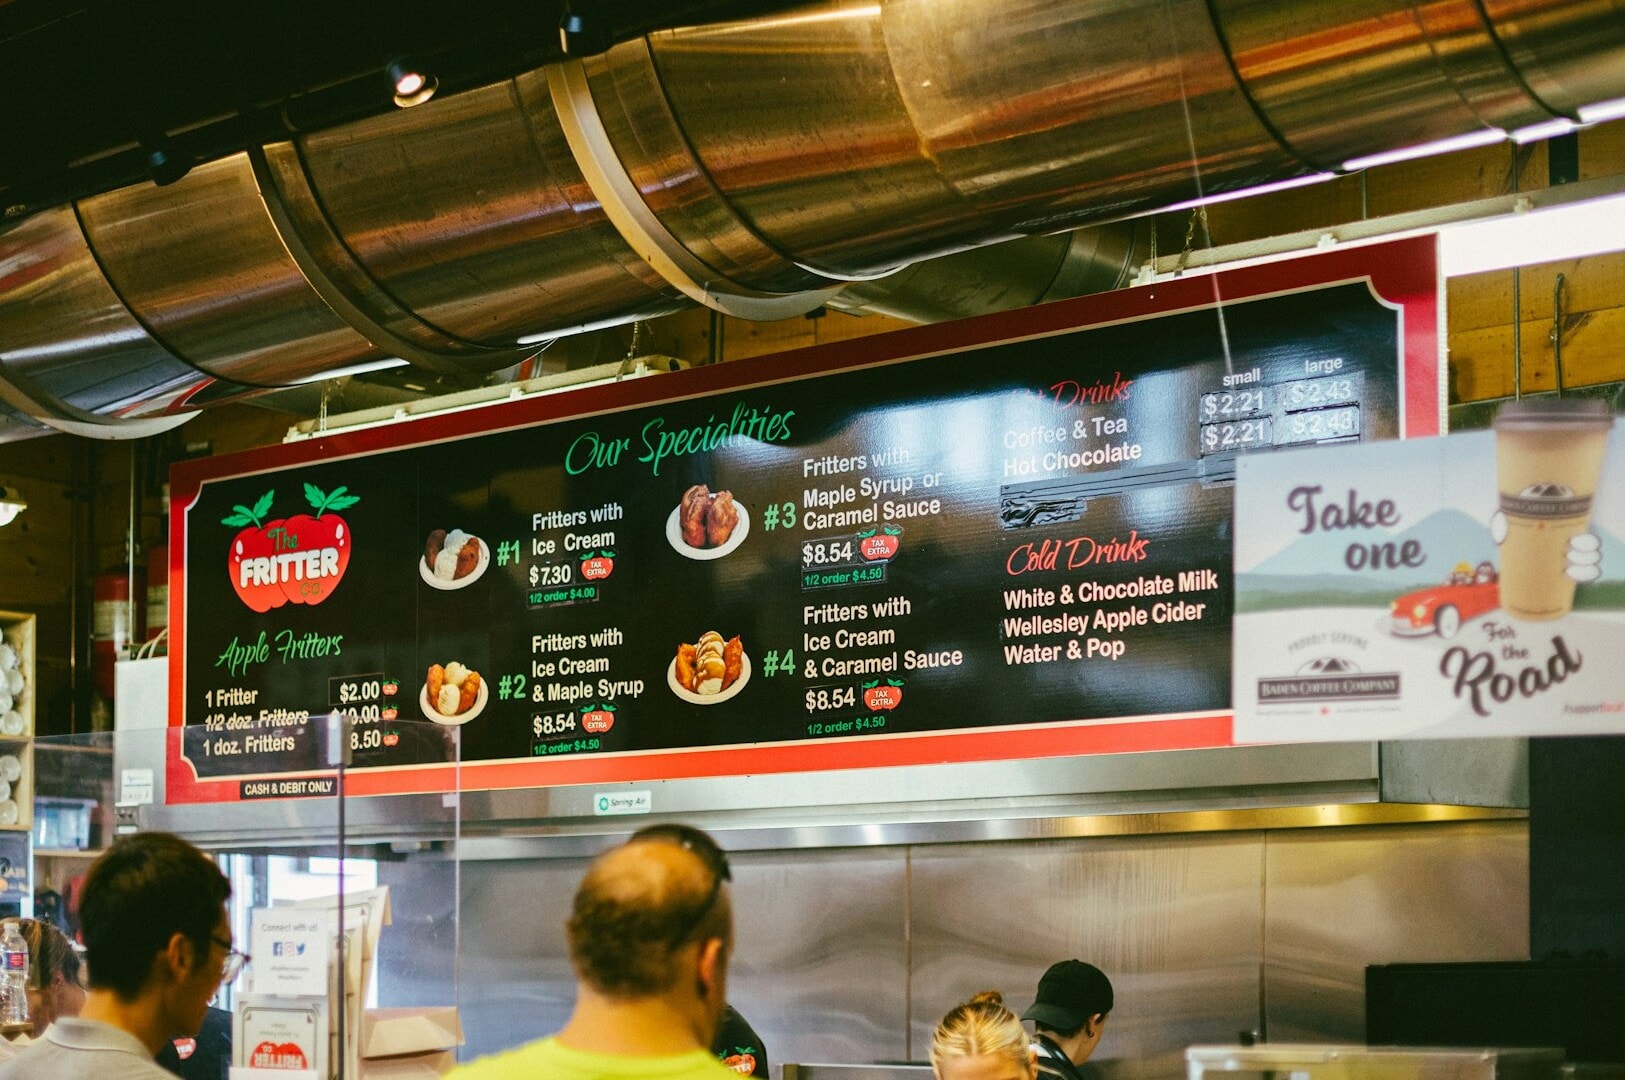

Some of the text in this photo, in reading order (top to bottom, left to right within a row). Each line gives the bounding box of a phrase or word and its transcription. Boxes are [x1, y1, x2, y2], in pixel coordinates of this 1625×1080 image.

[1222, 368, 1261, 386] small
[1305, 358, 1343, 374] large
[1050, 371, 1134, 410] Drinks
[1205, 391, 1263, 419] $2.21
[564, 401, 796, 477] Our Specialities
[1004, 416, 1127, 449] Coffee & Tea
[1205, 421, 1264, 449] $2.21
[803, 447, 910, 477] Fritters with
[1004, 442, 1142, 477] Hot Chocolate
[803, 471, 943, 509] Maple Syrup or
[533, 502, 623, 531] Fritters with
[764, 502, 796, 531] #3
[803, 499, 941, 530] Caramel Sauce
[1287, 485, 1400, 534] Take
[267, 528, 298, 551] The
[532, 531, 615, 556] Ice Cream
[867, 547, 890, 556] EXTRA
[871, 539, 885, 547] TAX
[497, 540, 520, 567] #1
[590, 561, 602, 569] TAX
[802, 541, 852, 566] $8.54
[1007, 530, 1150, 576] Cold Drinks
[1344, 539, 1427, 571] one
[240, 547, 339, 588] FRITTER
[529, 564, 571, 587] $7.30
[586, 567, 607, 576] EXTRA
[804, 567, 882, 586] 1/2 order $4.50
[529, 587, 595, 604] 1/2 order $4.00
[1004, 568, 1218, 611] White & Chocolate Milk
[803, 596, 911, 625] Fritters with
[1004, 600, 1206, 638] Wellesley Apple Cider
[532, 627, 623, 654] Fritters with
[803, 629, 895, 652] Ice Cream
[1482, 621, 1517, 641] For
[215, 629, 343, 677] Apple Fritters
[764, 649, 796, 677] #4
[804, 649, 963, 678] & Caramel Sauce
[1004, 638, 1125, 666] Water & Pop
[1502, 645, 1529, 659] the
[532, 657, 609, 678] Ice Cream
[1440, 635, 1583, 717] Road
[205, 687, 258, 708] 1 Fritter
[339, 680, 380, 704] $2.00
[499, 674, 526, 700] #2
[533, 678, 644, 704] & Maple Syrup
[874, 690, 888, 698] TAX
[1262, 679, 1396, 697] BADEN COFFEE COMPANY
[805, 687, 856, 713] $8.54
[870, 698, 894, 707] EXTRA
[205, 708, 309, 732] 1/2 doz. Fritters
[533, 712, 576, 738] $8.54
[587, 720, 607, 729] EXTRA
[591, 714, 603, 722] TAX
[807, 715, 885, 736] 1/2 order $4.50
[203, 734, 295, 756] 1 doz. Fritters
[534, 739, 599, 755] 1/2 order $4.50
[245, 780, 333, 795] CASH & DEBIT ONLY
[261, 923, 291, 932] Connect
